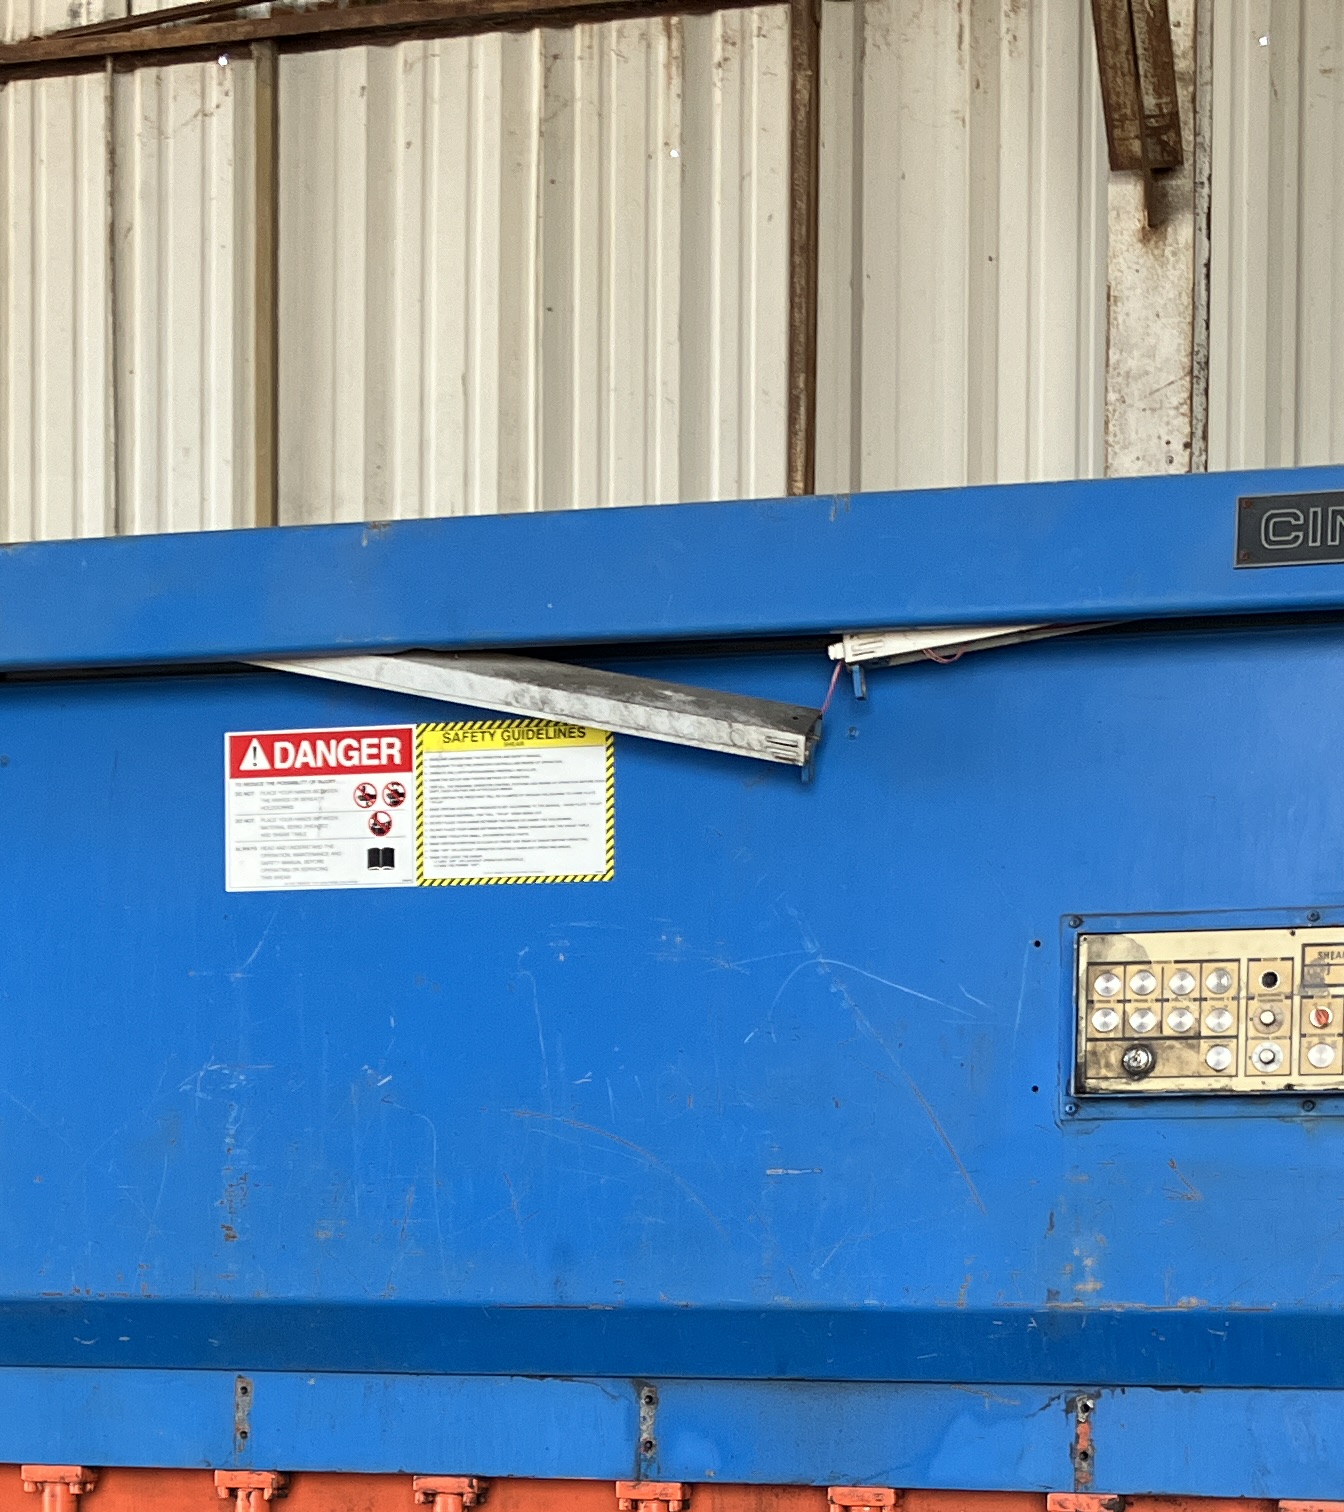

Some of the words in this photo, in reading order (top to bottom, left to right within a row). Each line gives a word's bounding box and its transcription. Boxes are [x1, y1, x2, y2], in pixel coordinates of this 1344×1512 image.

[442, 730, 497, 744] SAFETY
[501, 726, 586, 742] GUIDELINES
[273, 737, 402, 769] DANGER
